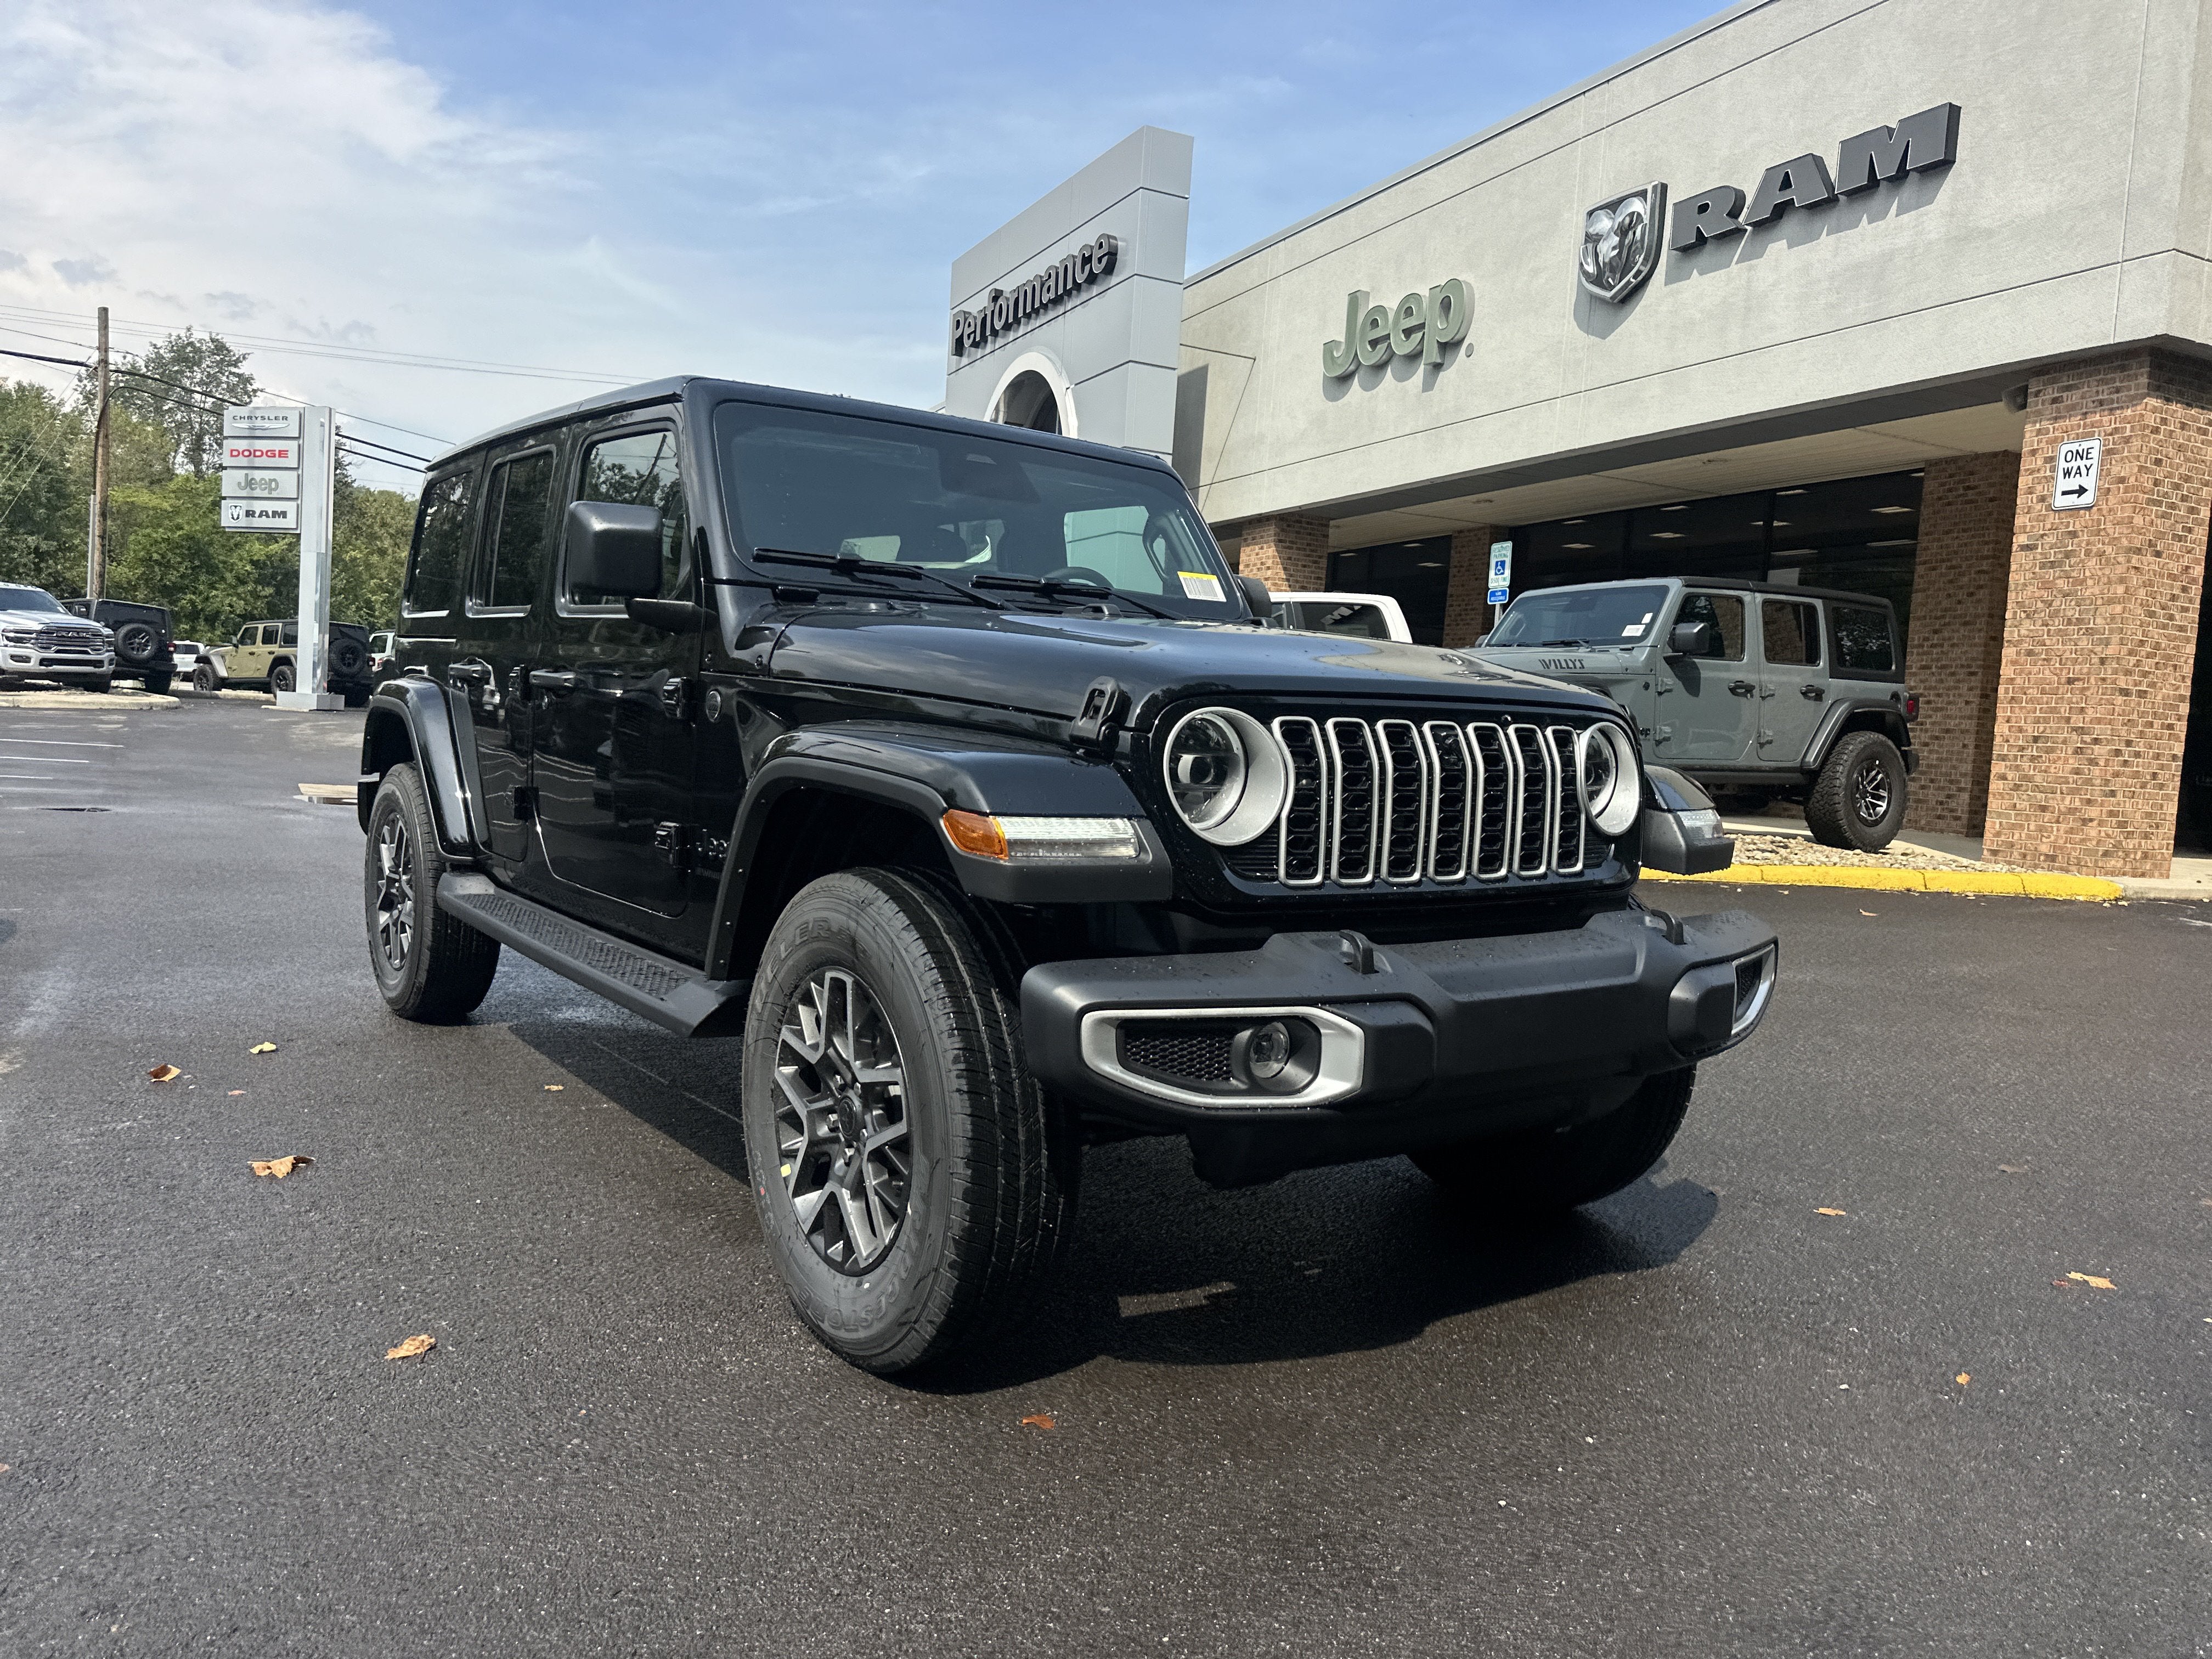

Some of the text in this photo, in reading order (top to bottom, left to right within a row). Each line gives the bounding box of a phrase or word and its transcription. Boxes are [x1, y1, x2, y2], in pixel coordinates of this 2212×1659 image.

[1669, 102, 1961, 252] RAM
[951, 233, 1119, 357] Performance
[1323, 278, 1475, 377] Jeep
[229, 449, 289, 458] DODGE
[2064, 447, 2095, 463] ONE
[2062, 463, 2094, 479] WAY
[238, 473, 279, 494] Jeep
[245, 510, 287, 518] RAM
[1538, 658, 1585, 669] WILLYS
